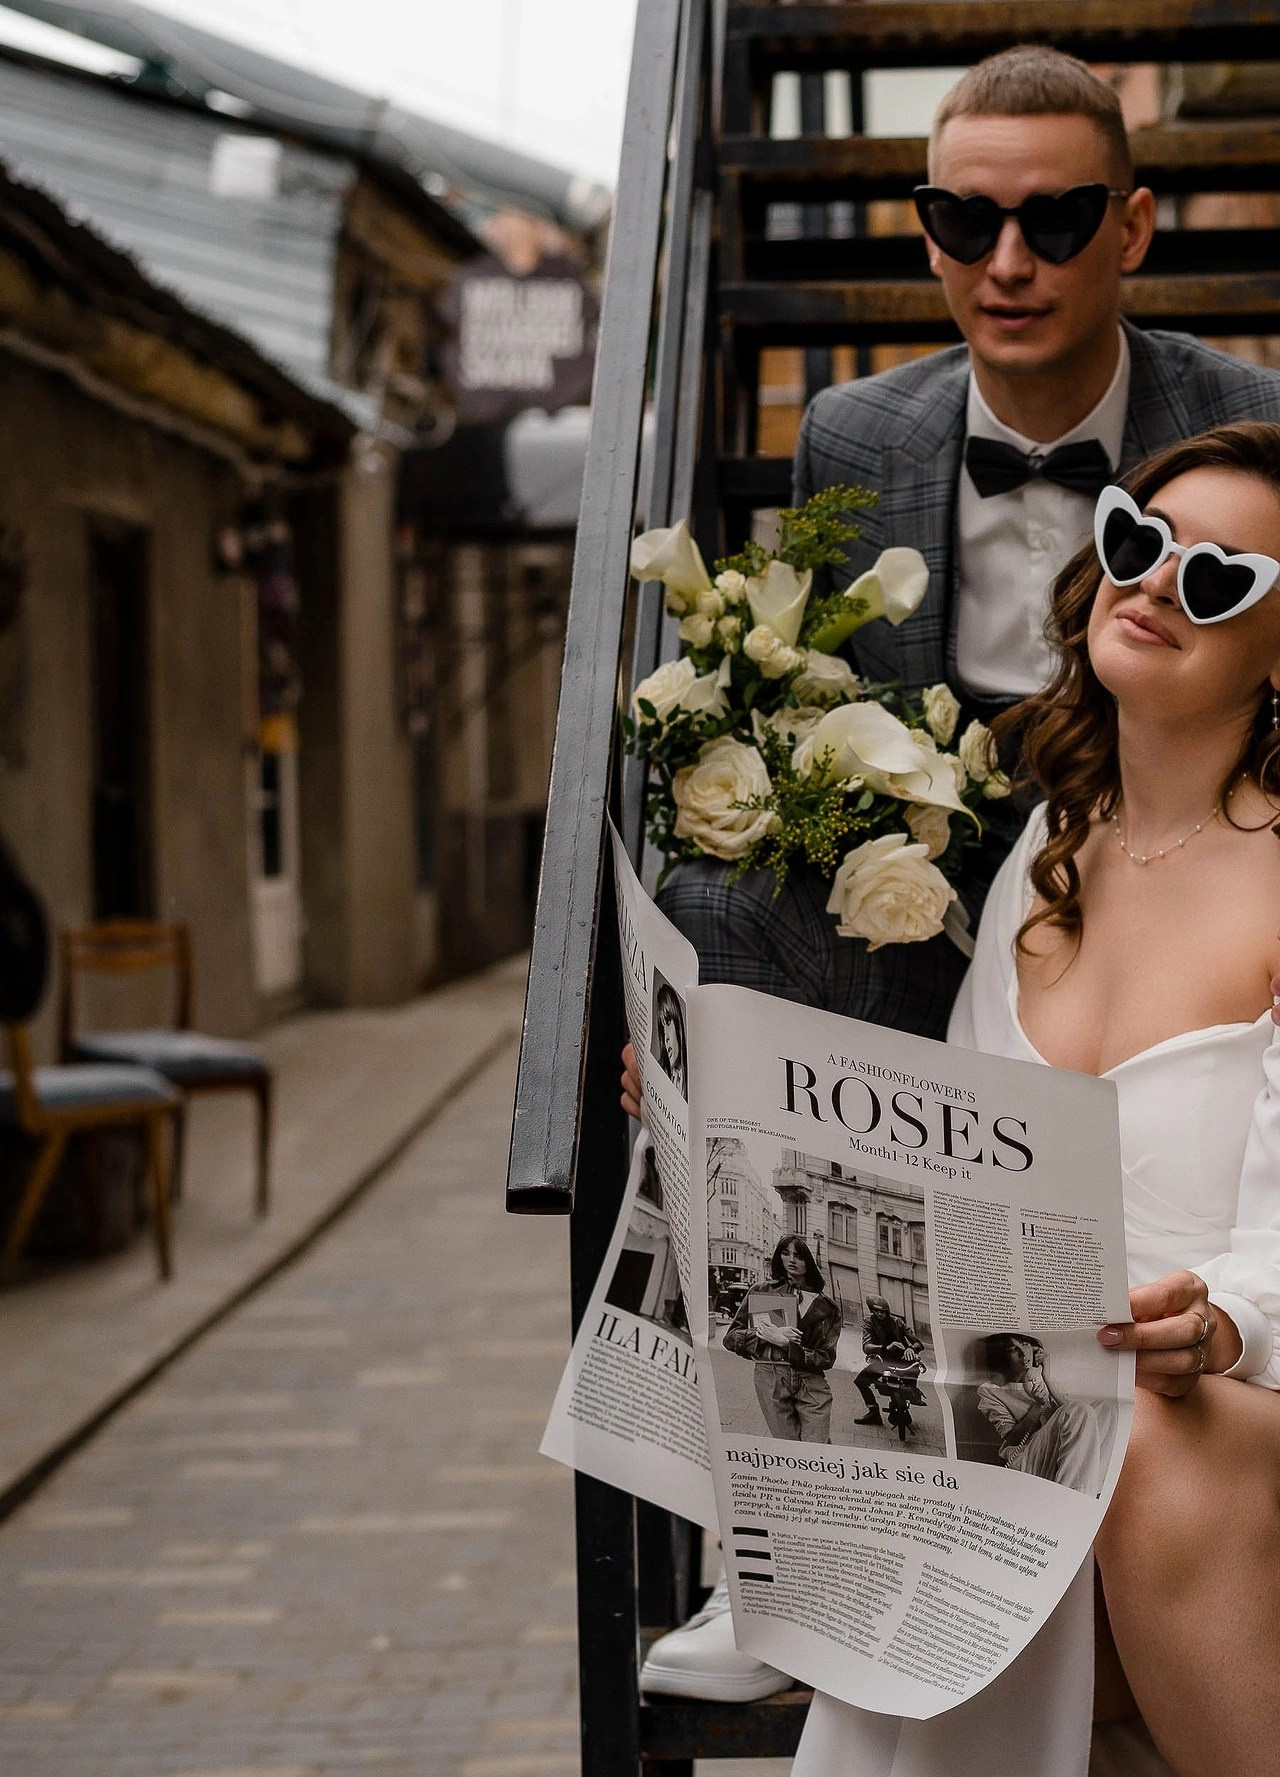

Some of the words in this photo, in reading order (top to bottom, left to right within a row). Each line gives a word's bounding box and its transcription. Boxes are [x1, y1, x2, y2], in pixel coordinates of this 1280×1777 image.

[827, 1053, 837, 1065] A
[646, 1081, 687, 1142] CORONATION
[778, 1057, 1034, 1172] ROSES
[739, 1119, 761, 1127] BIGGEST
[922, 1158, 956, 1179] Keep
[962, 1167, 972, 1180] it
[725, 1448, 845, 1479] najprosciej
[851, 1460, 889, 1480] jak
[895, 1466, 925, 1485] sie
[932, 1470, 959, 1490] da
[760, 1493, 773, 1501] PR
